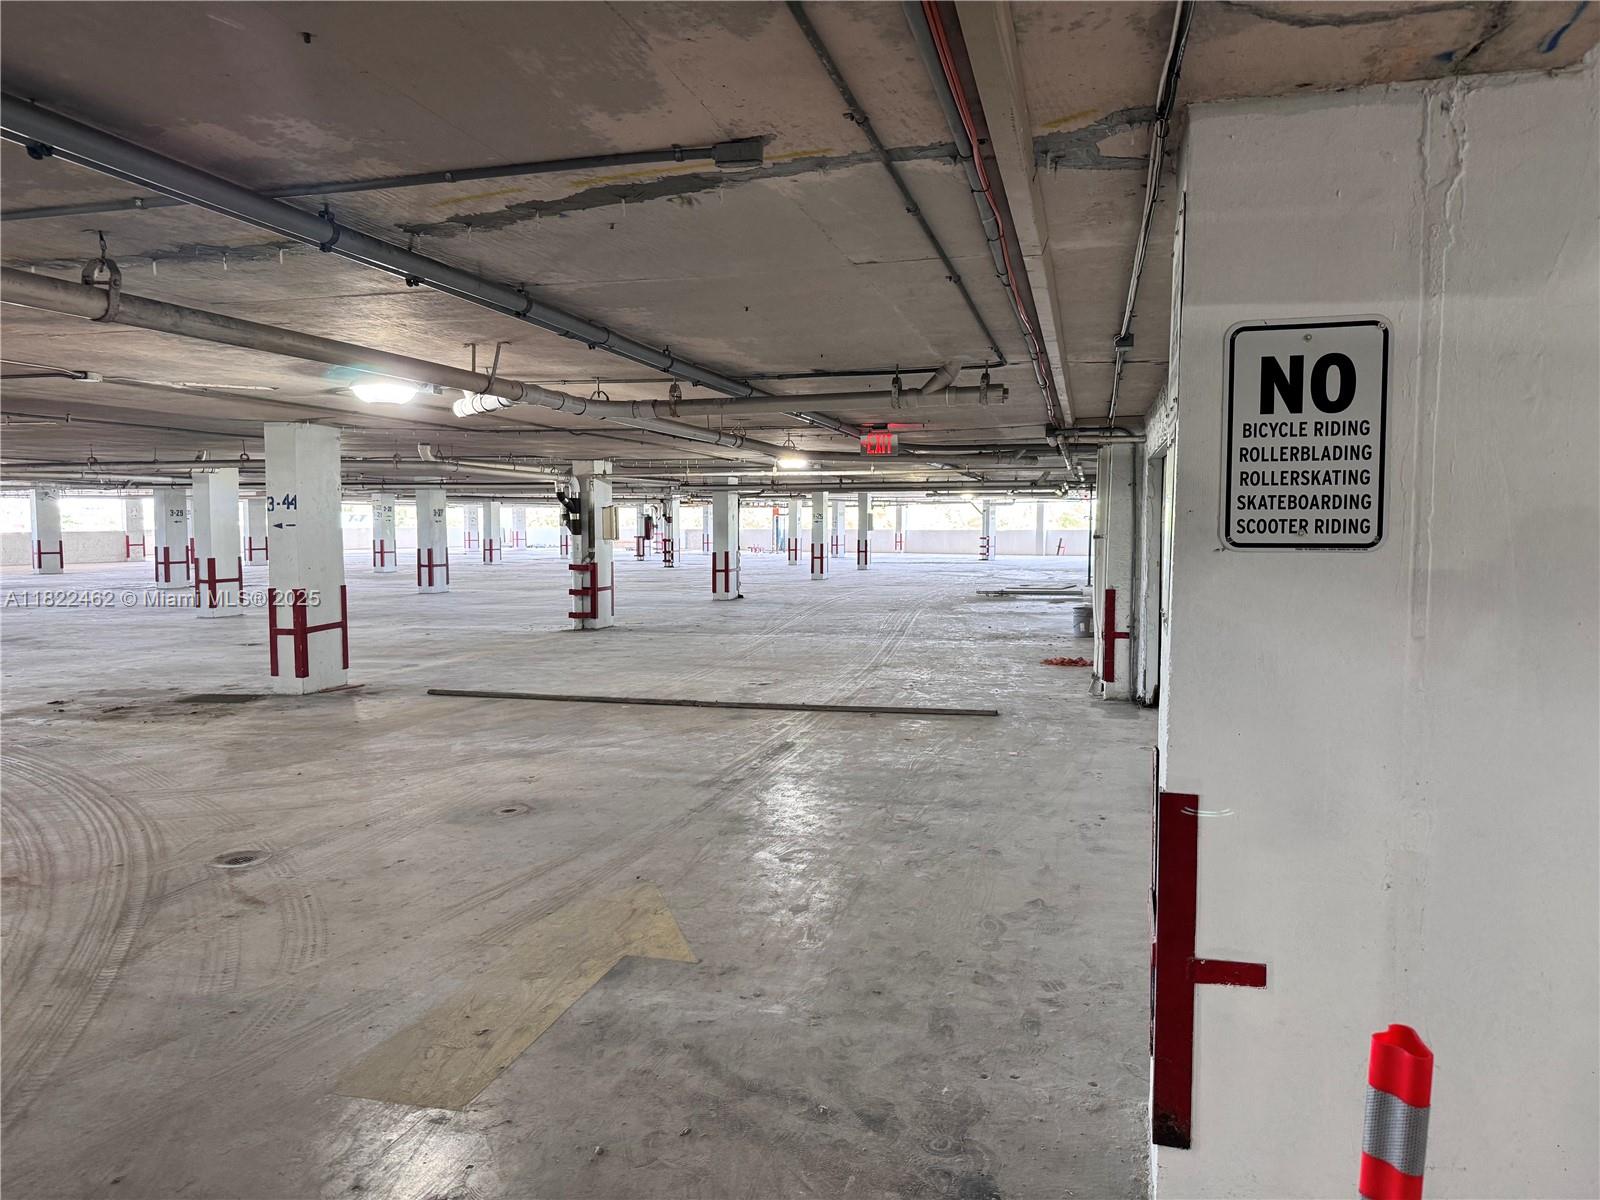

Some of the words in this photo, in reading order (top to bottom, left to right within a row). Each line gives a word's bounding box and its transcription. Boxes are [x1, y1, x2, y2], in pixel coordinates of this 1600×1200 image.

[1260, 352, 1357, 415] NO
[1242, 421, 1308, 438] BICYCLE
[1313, 419, 1371, 437] RIDING
[866, 433, 892, 454] EXIT
[1239, 444, 1372, 463] ROLLERBLADING
[1239, 469, 1371, 486] ROLLERSKATING
[267, 493, 297, 512] 3-44
[1236, 493, 1372, 511] SKATEBOARDING
[1236, 518, 1309, 535] SCOOTER
[1314, 518, 1371, 534] RIDING
